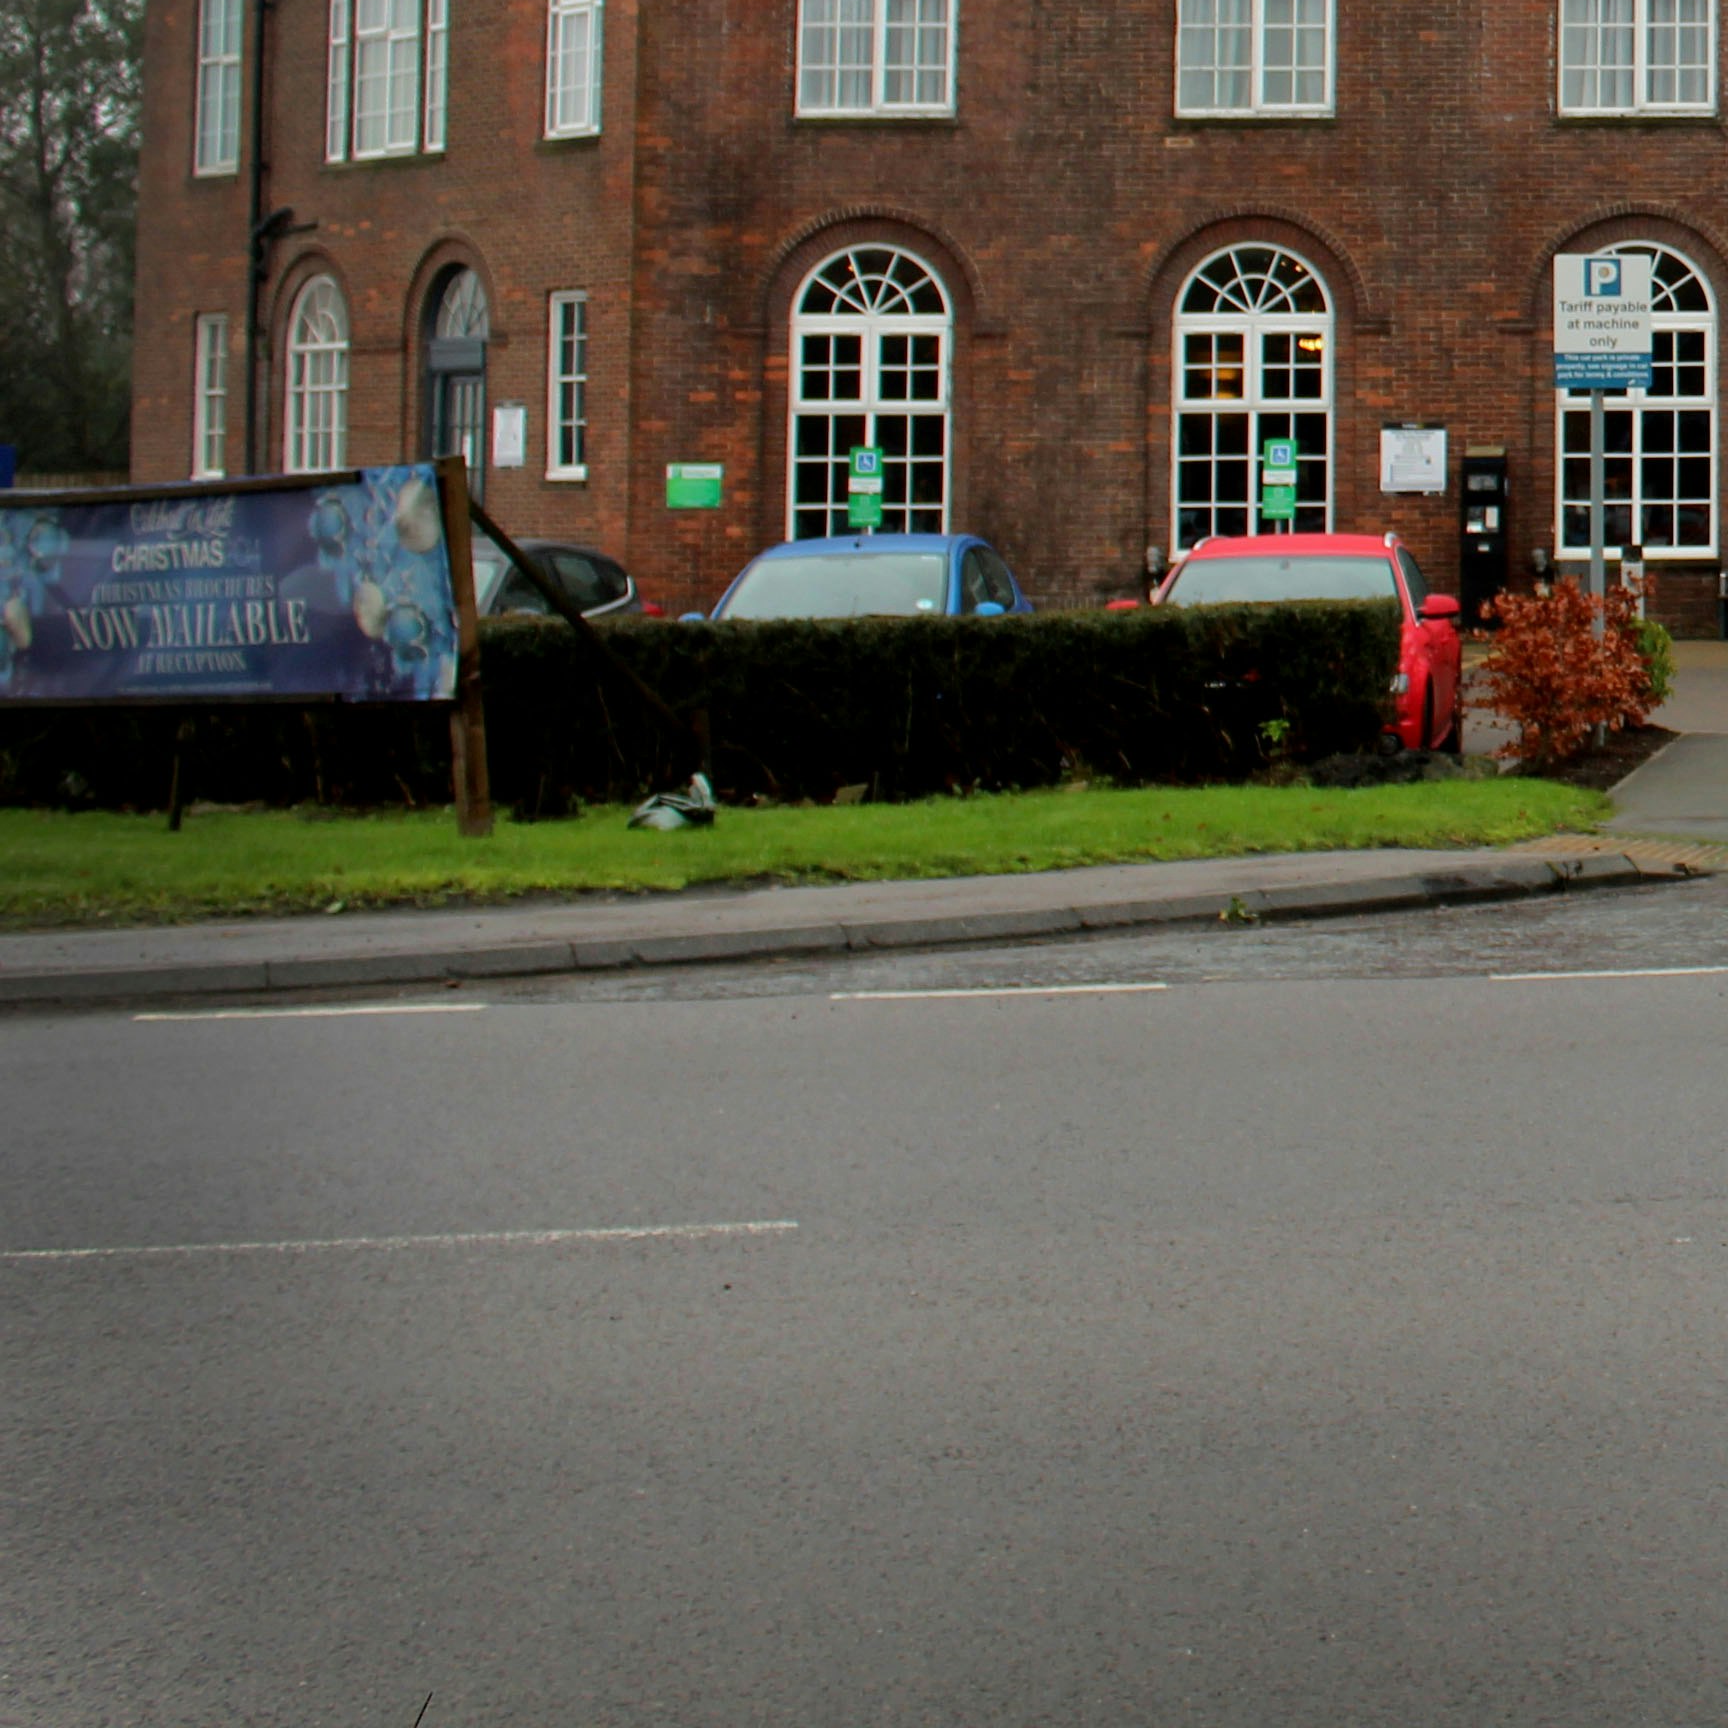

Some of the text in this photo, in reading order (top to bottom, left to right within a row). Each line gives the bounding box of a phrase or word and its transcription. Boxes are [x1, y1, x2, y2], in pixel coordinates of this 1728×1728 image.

[1590, 261, 1618, 295] P
[1560, 301, 1648, 315] Tariff payable
[1567, 318, 1640, 330] at machine
[1589, 336, 1617, 349] only
[111, 539, 226, 573] CHRISTMAS
[91, 575, 275, 604] CHRISTMAS BROCHURES
[66, 599, 313, 651] NOW AVAILABLE
[155, 651, 248, 673] RECEPTION
